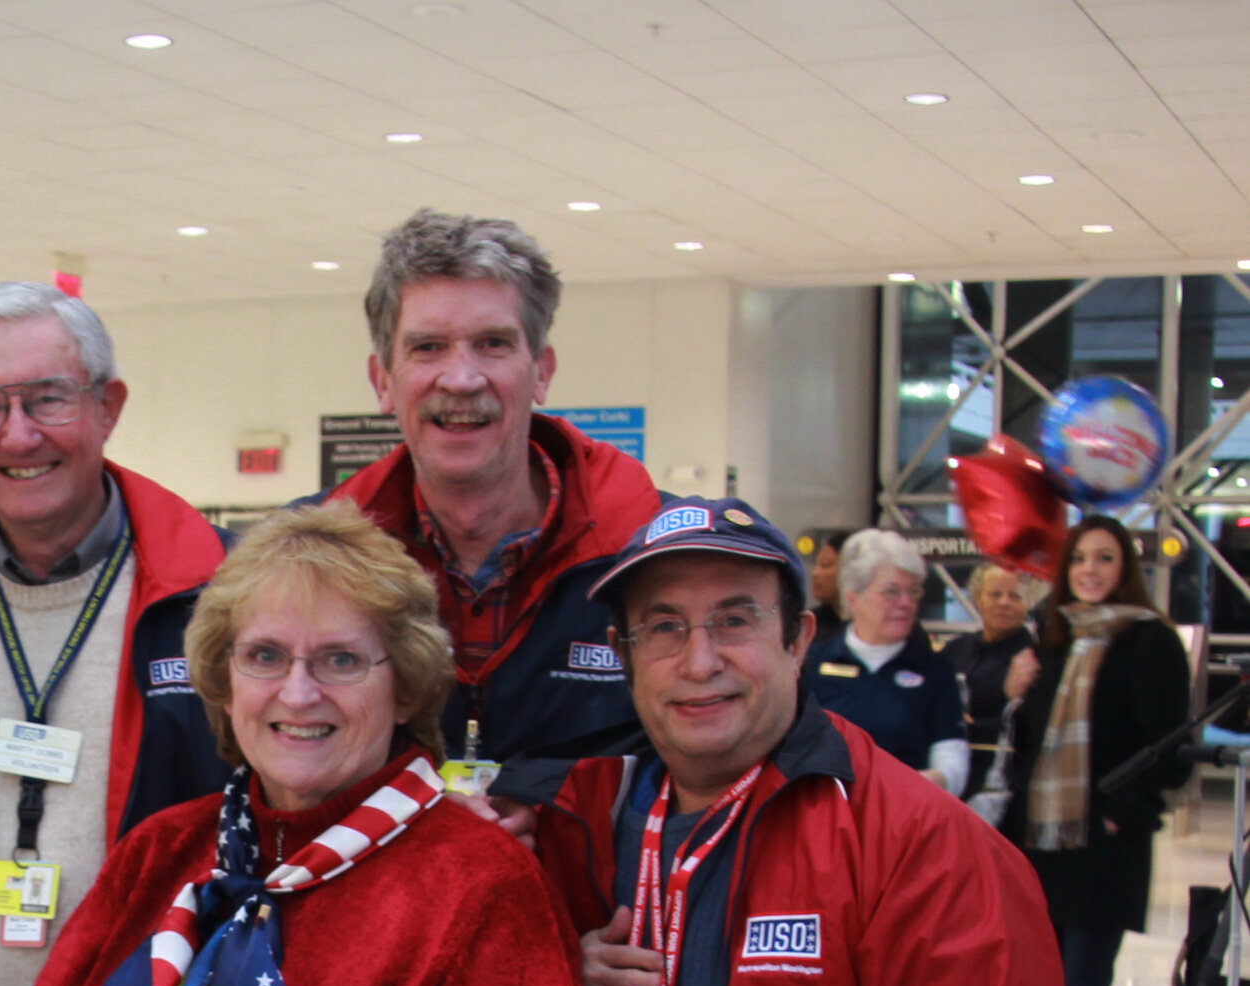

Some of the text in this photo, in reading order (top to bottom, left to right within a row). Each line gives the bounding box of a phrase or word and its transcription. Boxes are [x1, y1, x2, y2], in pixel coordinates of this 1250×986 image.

[656, 510, 695, 533] USO
[54, 647, 73, 674] POLICE
[68, 597, 100, 648] DEPARTMENT
[160, 660, 189, 681] US
[579, 647, 614, 667] USO
[638, 848, 651, 884] TROOPS
[636, 886, 646, 906] OUR
[652, 849, 664, 950] SUPPORT OUR TROOPS
[671, 889, 684, 930] SUPPORT
[668, 931, 679, 953] OUR
[758, 921, 807, 952] USO
